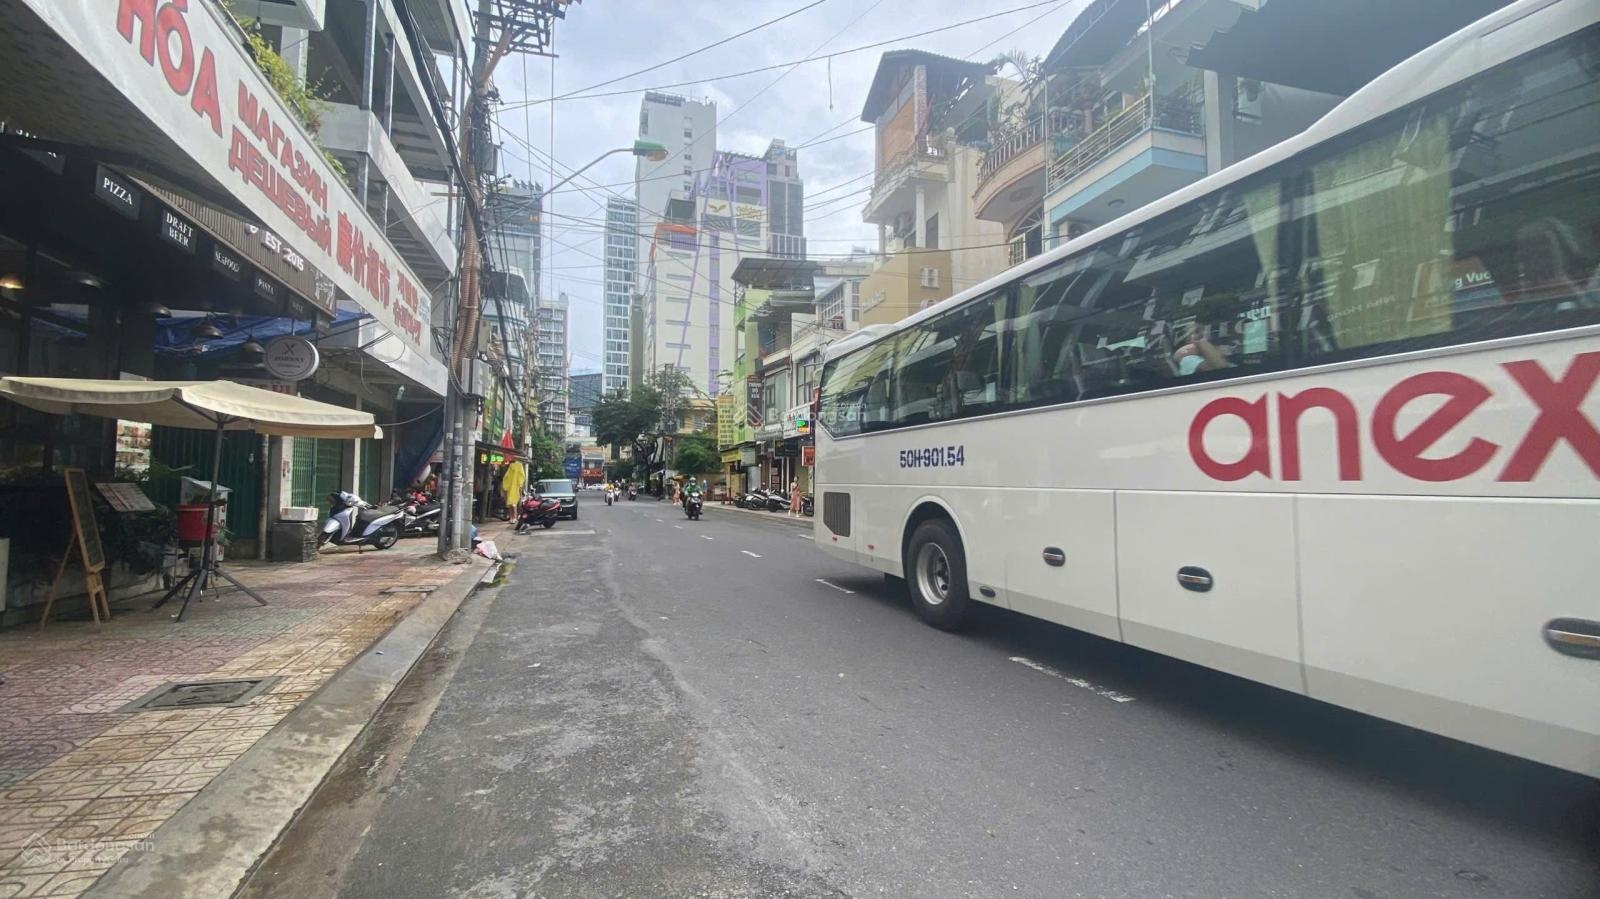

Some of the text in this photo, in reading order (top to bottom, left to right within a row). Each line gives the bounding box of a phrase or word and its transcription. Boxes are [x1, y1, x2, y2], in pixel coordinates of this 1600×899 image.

[238, 79, 328, 214] МАГАЗИН
[103, 177, 133, 205] PIZZA
[228, 124, 332, 257] ДЕШЕВЫЙ
[166, 212, 193, 238] DRAFT
[169, 226, 189, 247] BEER
[264, 230, 281, 253] EST
[1188, 351, 1600, 482] anex
[900, 445, 964, 468] 50H-901.54
